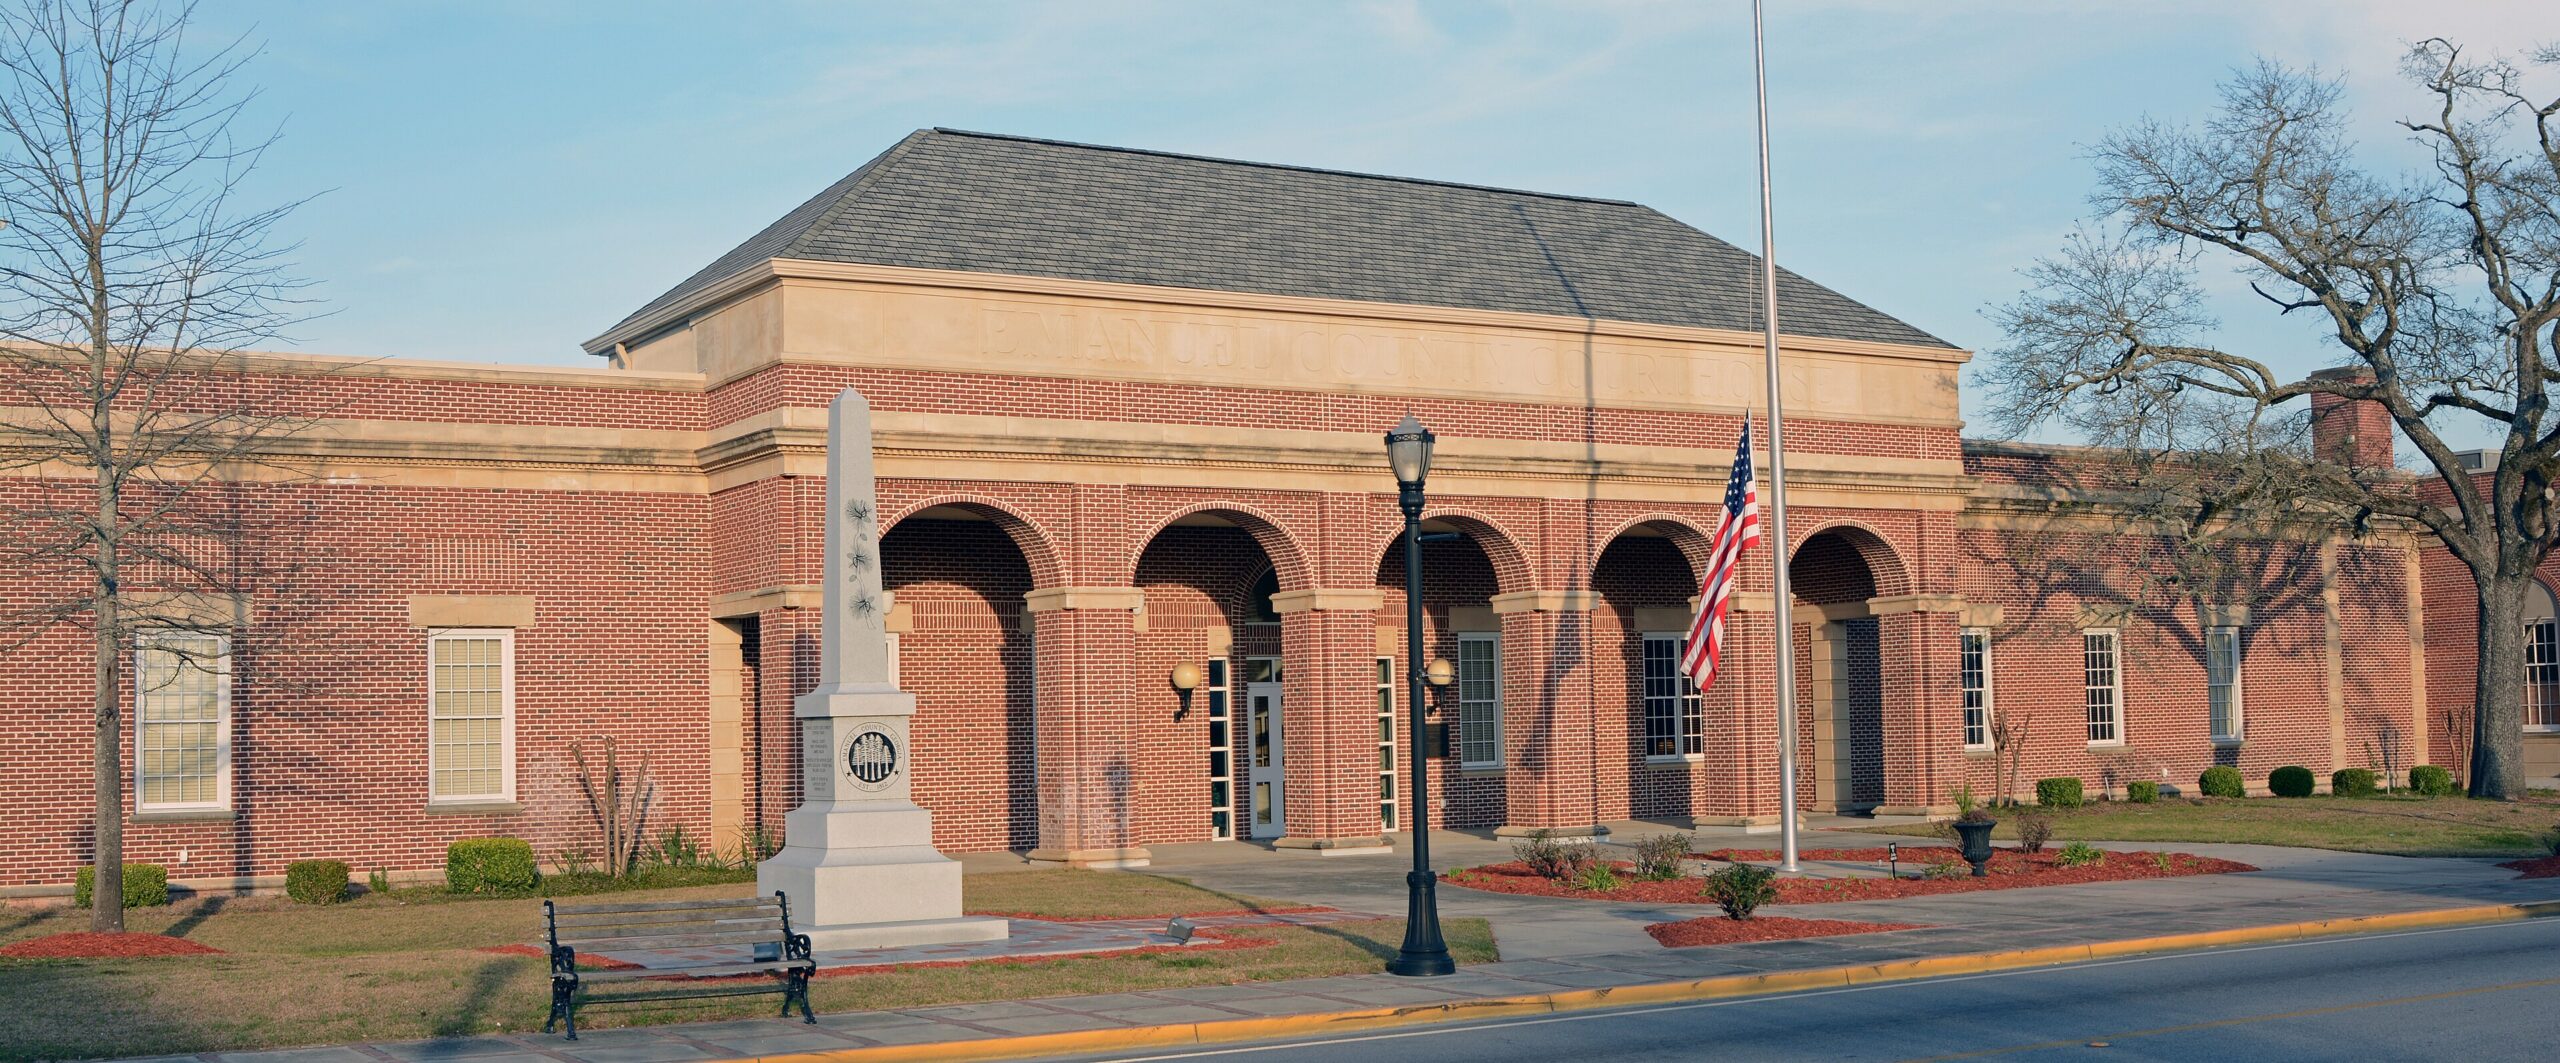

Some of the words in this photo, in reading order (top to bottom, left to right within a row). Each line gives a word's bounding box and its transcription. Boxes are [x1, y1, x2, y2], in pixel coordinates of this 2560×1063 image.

[981, 307, 1272, 369] EMANUEL
[1298, 329, 1512, 384] COUNTY
[842, 734, 857, 762] EMANUEL
[860, 724, 886, 733] COUNTY
[889, 733, 902, 760] GEORGIA
